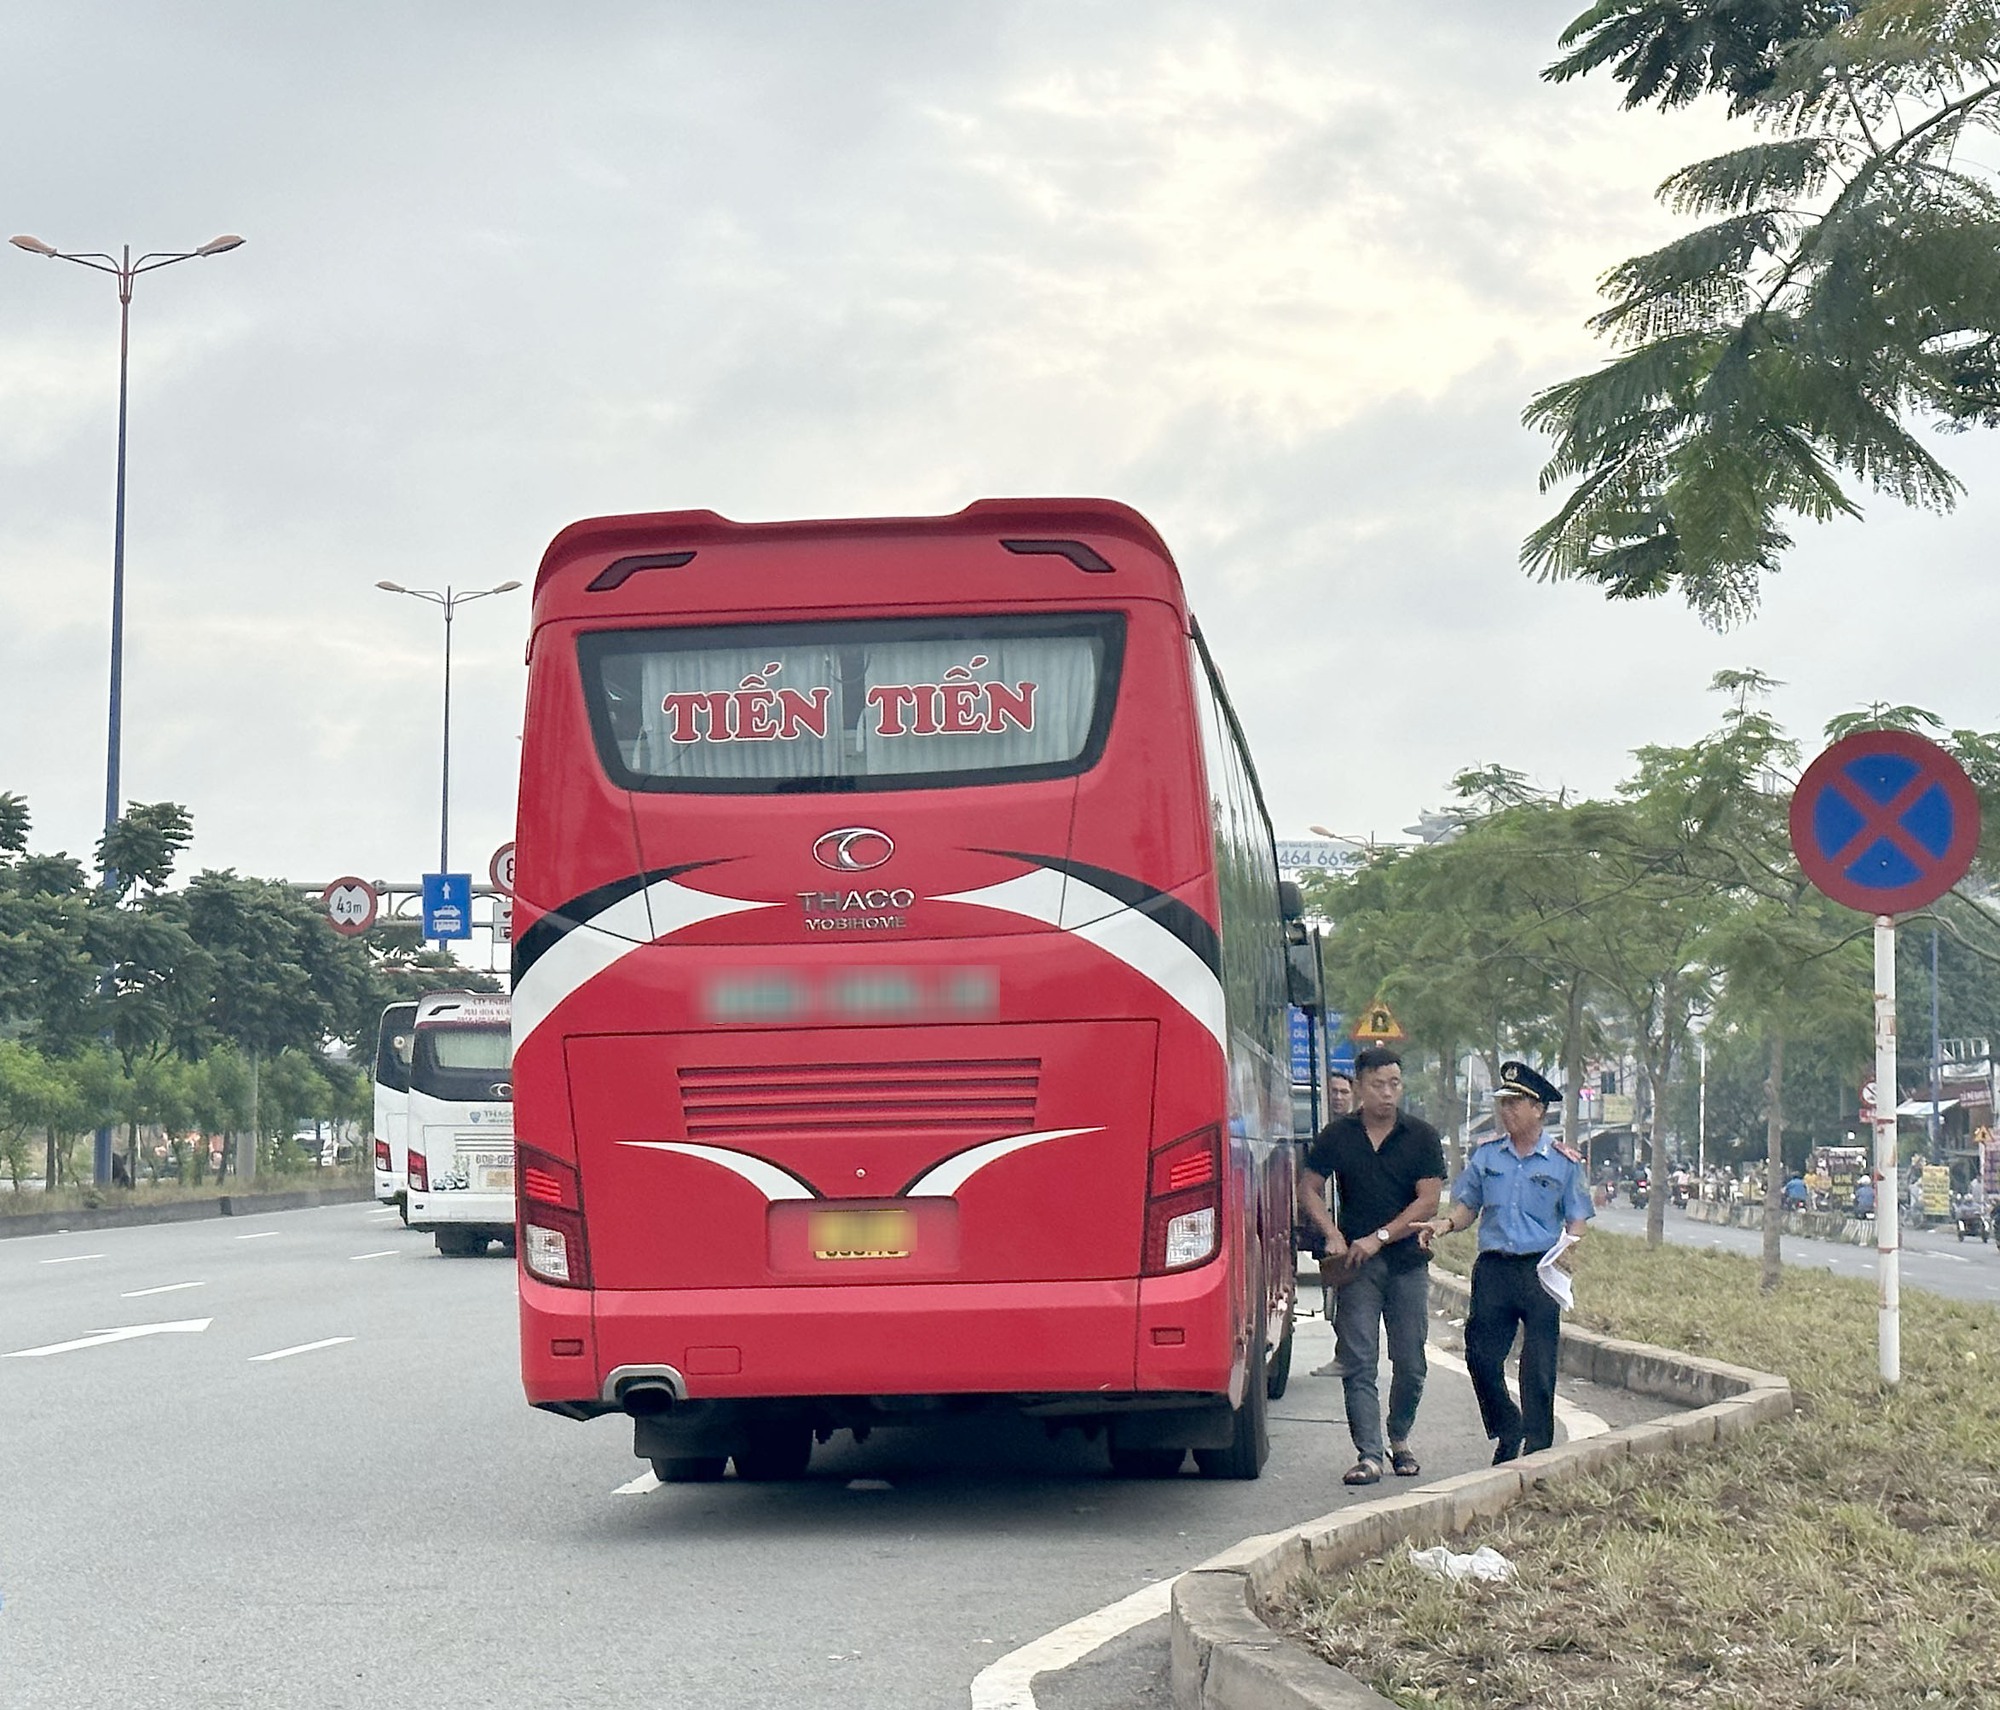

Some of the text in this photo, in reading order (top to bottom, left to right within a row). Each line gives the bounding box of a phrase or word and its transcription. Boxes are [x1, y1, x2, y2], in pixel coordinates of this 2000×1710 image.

[662, 655, 1038, 743] TIẾN TIẾN
[796, 888, 915, 912] THACO
[805, 916, 907, 930] MOBIHOME
